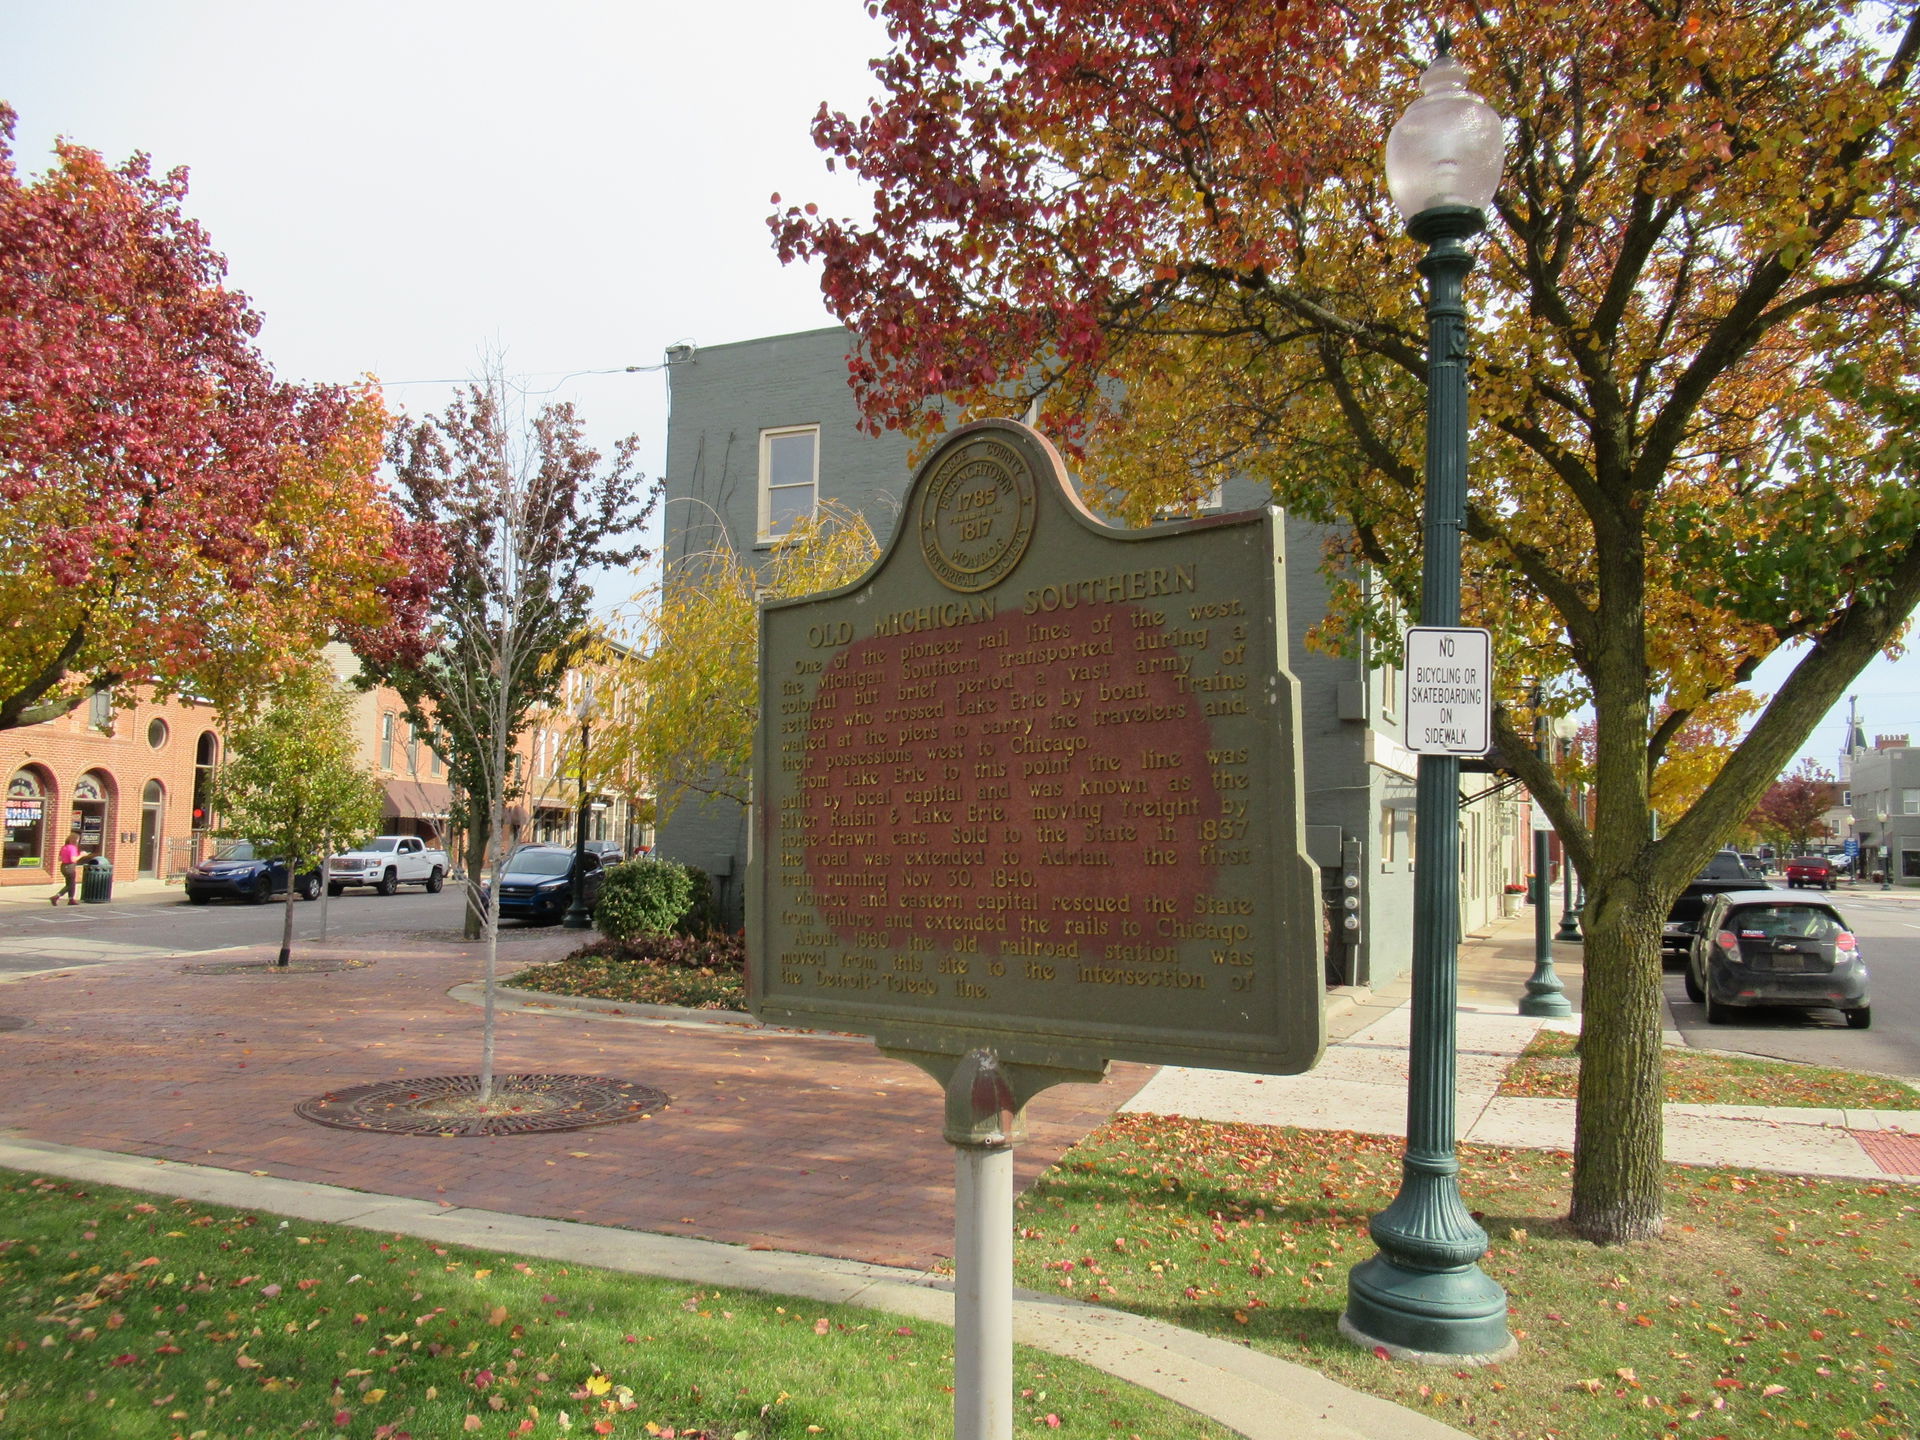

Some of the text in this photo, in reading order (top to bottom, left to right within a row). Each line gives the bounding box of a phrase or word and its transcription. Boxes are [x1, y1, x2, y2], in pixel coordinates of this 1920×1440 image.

[930, 444, 1026, 497] MONROE COUNTY
[940, 463, 1014, 510] FRENCHTOWN
[958, 487, 997, 512] 1785
[960, 519, 993, 542] 1817
[927, 528, 1029, 586] HISTORICAL SOCIETY
[952, 539, 1006, 568] MONROE
[807, 563, 1196, 648] OLD MICHIGAN SOUTHERN
[794, 660, 821, 675] One
[834, 653, 849, 669] of
[862, 650, 886, 664] the
[900, 639, 963, 664] pioneer
[978, 628, 1009, 649] rail
[1027, 624, 1071, 643] lines
[1091, 614, 1112, 634] of
[1131, 611, 1166, 628] the
[1440, 639, 1454, 657] NO
[782, 626, 1246, 696] the Michigan Southern transported during a
[1417, 668, 1476, 684] BICYCLING OR
[780, 643, 1246, 714] colorful but brief period a vast army of
[780, 715, 833, 733] settlers
[844, 710, 873, 726] who
[884, 703, 945, 724] crossed
[956, 697, 998, 716] Lake
[1010, 691, 1047, 710] Erie
[1061, 688, 1084, 708] by
[1173, 672, 1247, 694] Trains
[1412, 687, 1481, 704] SKATEBOARDING
[782, 694, 1248, 752] waited at the piers to carry the travelers and
[1440, 708, 1452, 723] ON
[1425, 728, 1467, 744] SIDEWALK
[781, 736, 1092, 772] their possessions west to Chicago.
[794, 748, 1248, 790] From Lake Erie to this point the line was
[781, 769, 1249, 810] built by local capital and was known as the
[780, 814, 819, 829] River
[830, 810, 877, 826] Raisin
[889, 808, 899, 825] &
[912, 808, 953, 824] Lake
[1033, 802, 1103, 824] moving
[1120, 799, 1200, 823] freight
[1219, 798, 1248, 817] by
[780, 819, 1249, 848] horse-drawn cars. Sold to the State in 1837
[780, 844, 1250, 867] the road was extended to Adrian, the first
[780, 871, 814, 886] train
[826, 871, 888, 891] running
[949, 869, 976, 889] 30,
[990, 869, 1038, 889] 1840.
[794, 892, 1254, 915] Monroe and eastern capital rescued the State
[781, 910, 813, 925] from
[825, 910, 873, 927] failure
[885, 913, 913, 928] and
[925, 914, 1008, 931] extended
[1020, 915, 1050, 933] the
[1065, 916, 1109, 935] rails
[1121, 919, 1142, 937] to
[794, 929, 1255, 966] About 1860 the old railroad station was
[781, 951, 1255, 991] moved from this site to the intersection of
[781, 968, 991, 999] the Detroit-Toledo line.
